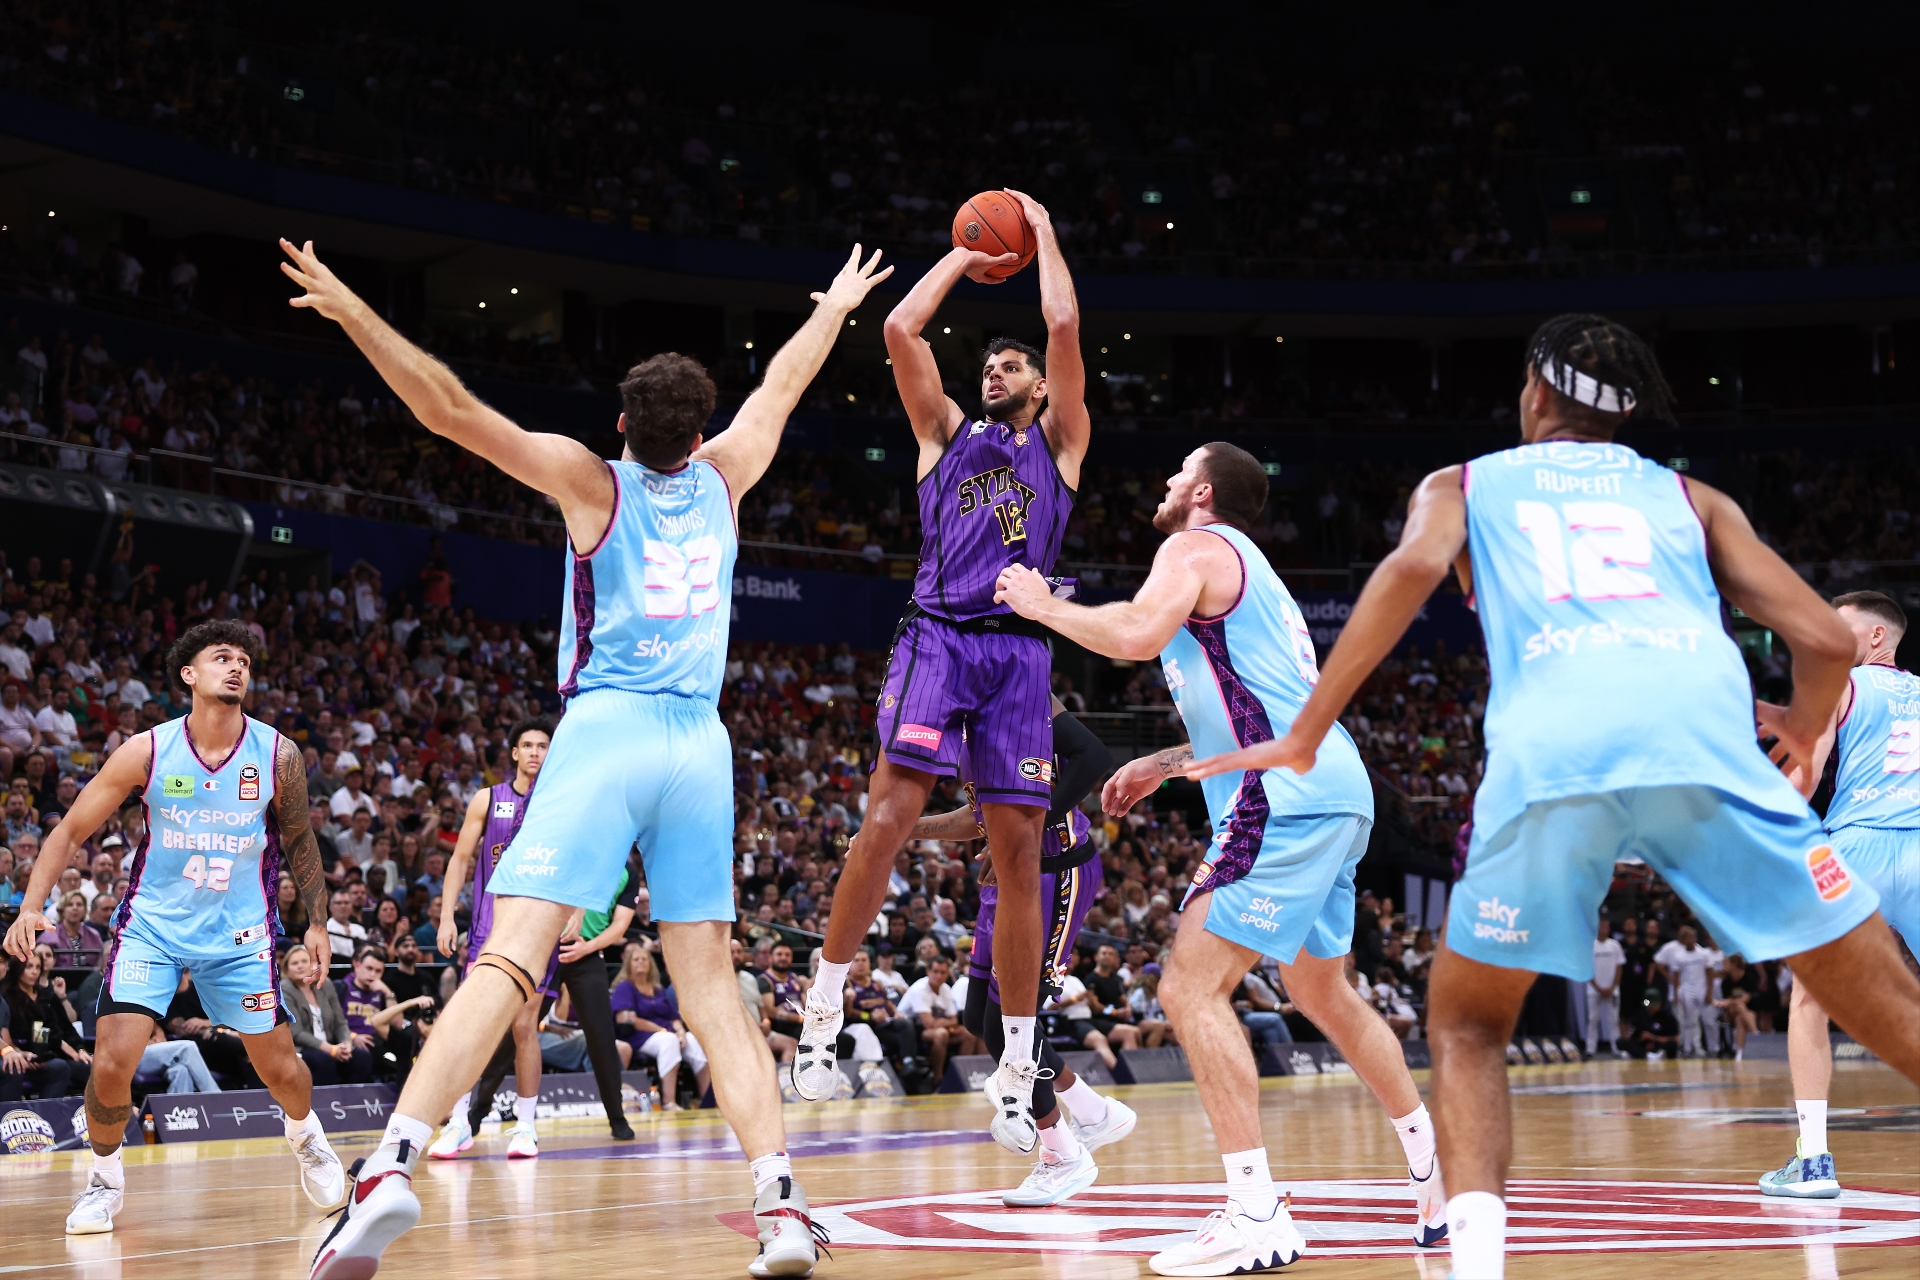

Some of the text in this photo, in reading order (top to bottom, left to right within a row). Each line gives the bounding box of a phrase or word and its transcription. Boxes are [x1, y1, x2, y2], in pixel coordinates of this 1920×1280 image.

[1535, 469, 1622, 495] RUPERT
[958, 466, 1036, 521] SYDY
[994, 501, 1026, 545] 12
[1516, 501, 1663, 602] 12
[643, 535, 723, 619] 33
[746, 577, 801, 600] Bank
[1306, 599, 1350, 620] udo
[634, 634, 680, 661] sky
[1523, 623, 1587, 661] sky
[901, 730, 938, 741] Carma
[243, 768, 255, 777] NBL
[1023, 764, 1037, 774] NBL
[160, 804, 199, 828] sky
[523, 843, 559, 864] sky
[183, 854, 234, 893] 42
[515, 864, 558, 876] SPORT
[1817, 866, 1846, 893] KING
[1249, 896, 1283, 919] sky
[1478, 897, 1520, 928] sky
[1239, 912, 1280, 933] SPORT
[1474, 922, 1530, 943] SPORT
[124, 970, 145, 979] ON
[125, 960, 146, 970] NE
[244, 999, 255, 1007] NBL
[1836, 1043, 1868, 1056] HOOP
[0, 1117, 51, 1139] HOOPS
